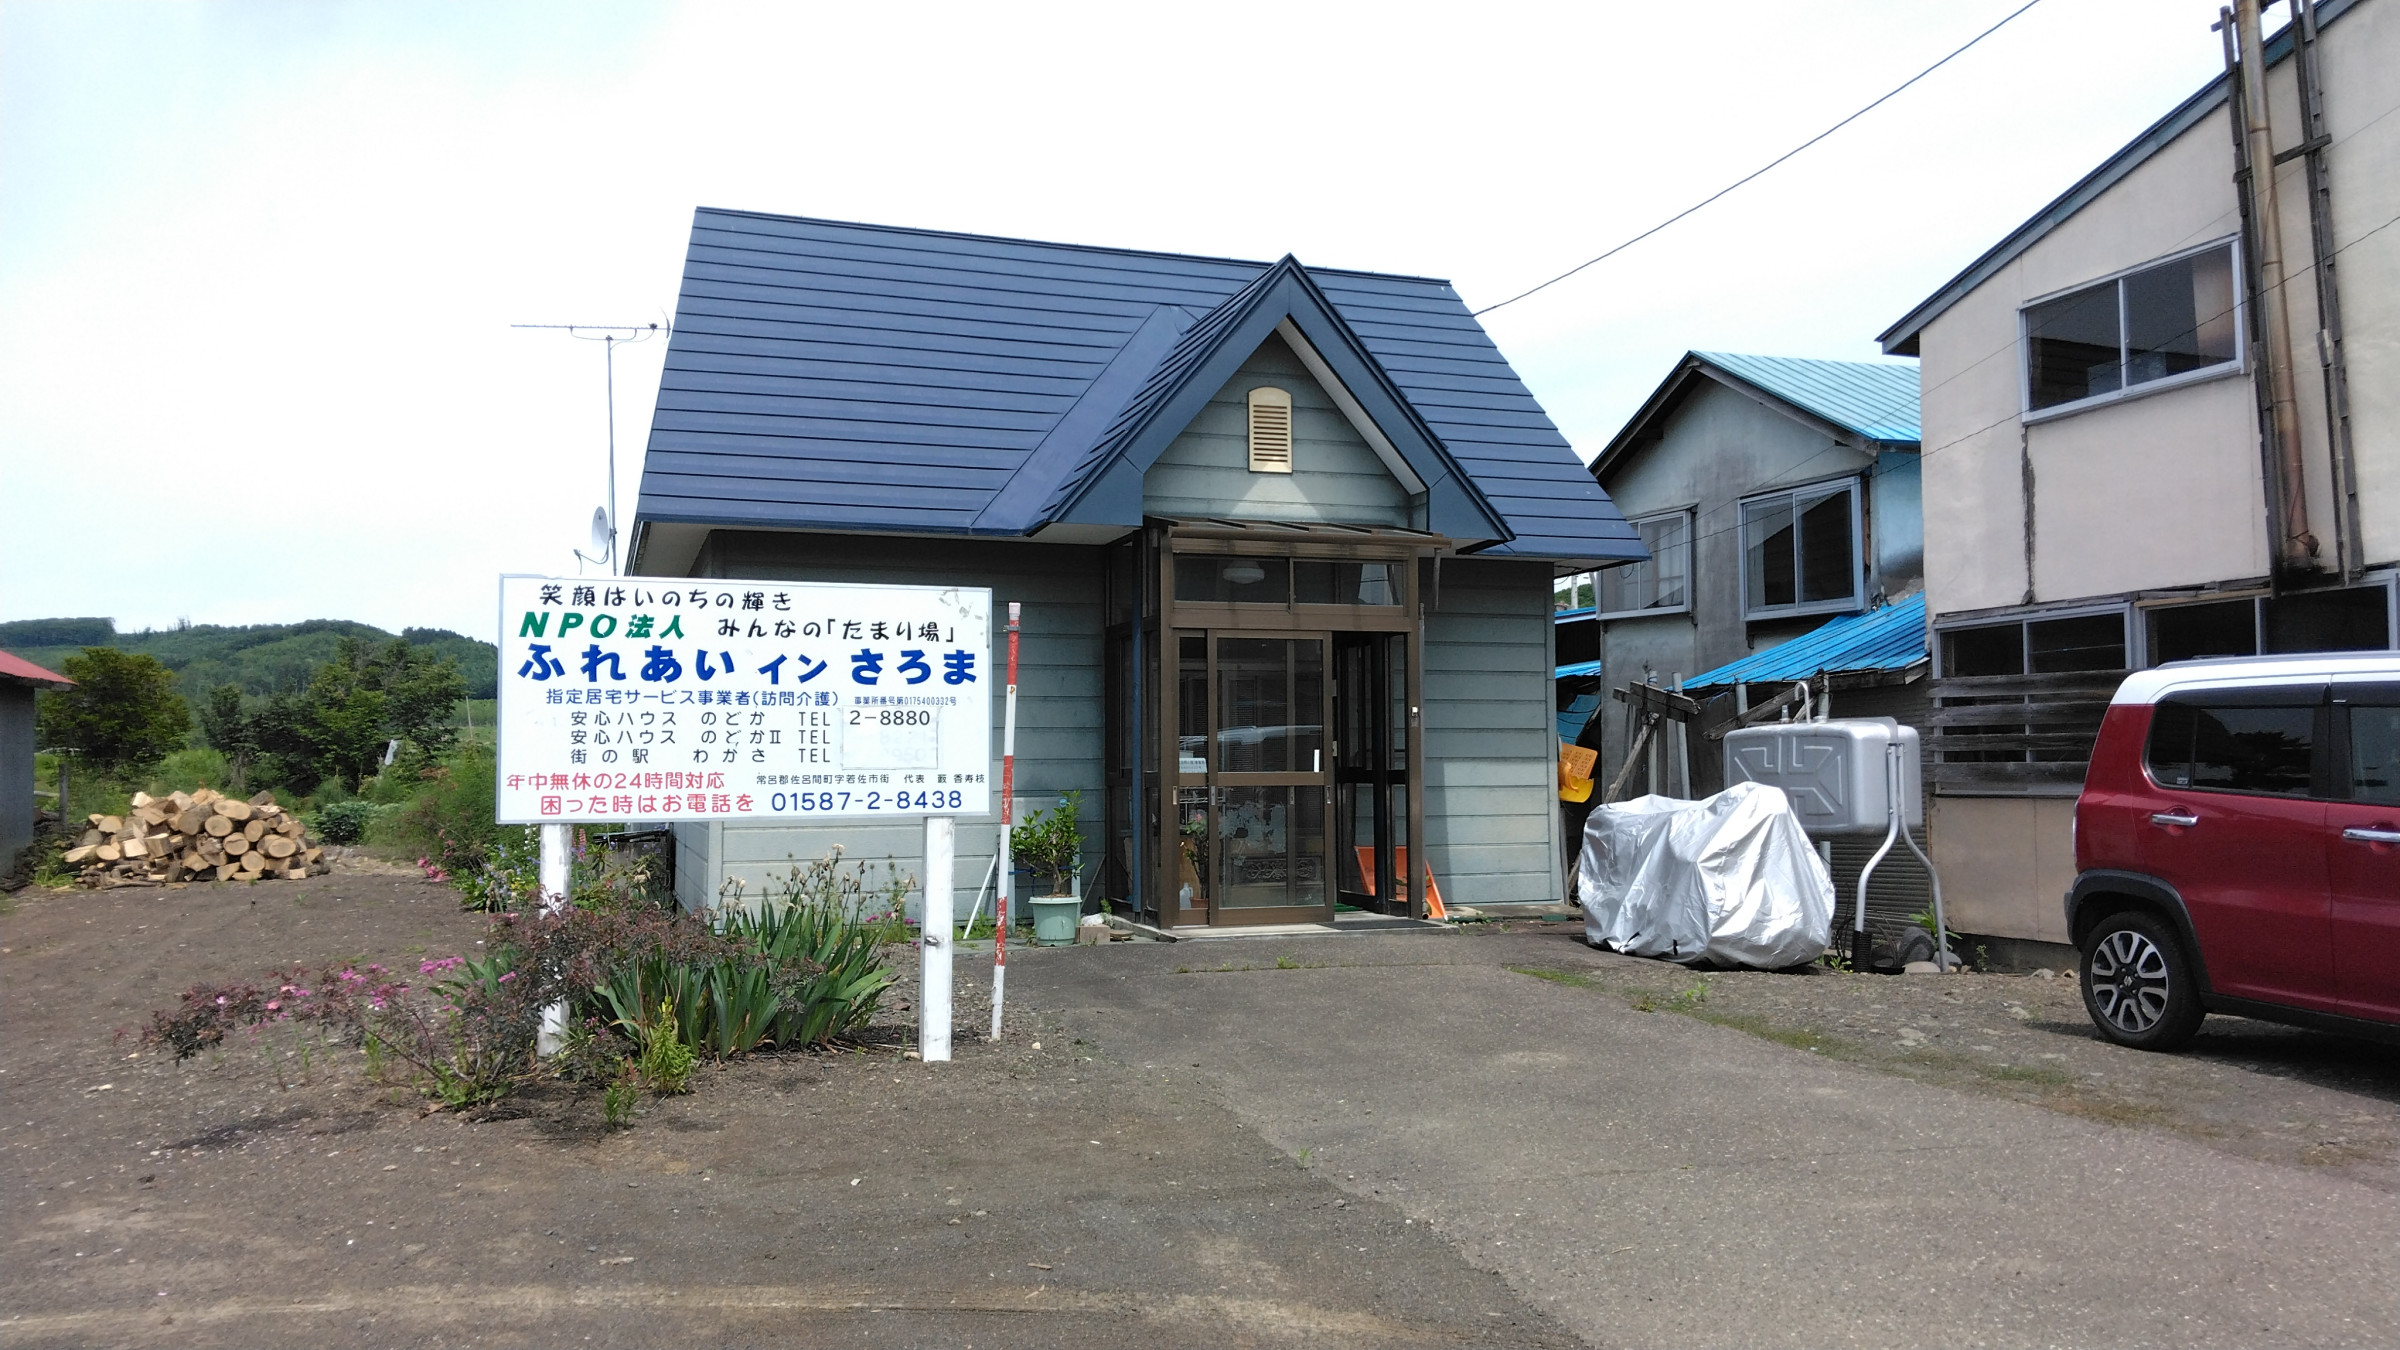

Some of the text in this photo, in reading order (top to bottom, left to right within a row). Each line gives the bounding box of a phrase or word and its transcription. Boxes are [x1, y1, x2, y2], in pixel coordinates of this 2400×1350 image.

[539, 583, 792, 612] 笑顔はいのちの輝き
[518, 611, 955, 643] NPO法人 みんなの「たまり場」
[517, 642, 977, 686] ふれあい イン さろま
[545, 688, 839, 707] 指定居宅サービス事業者(訪問介護)
[570, 709, 931, 727] 安心ハウス のどか TEL 2-8880
[570, 729, 676, 745] 安心ハウス
[798, 729, 831, 745] TEL
[798, 748, 831, 763] TEL
[506, 771, 725, 791] 年中無休の24時間対応
[756, 774, 890, 785] 常呂郡佐呂間町字若佐市街
[904, 774, 925, 784] 代表
[540, 793, 755, 815] 困った時はお電話を
[771, 790, 963, 812] 01587-2-8438
